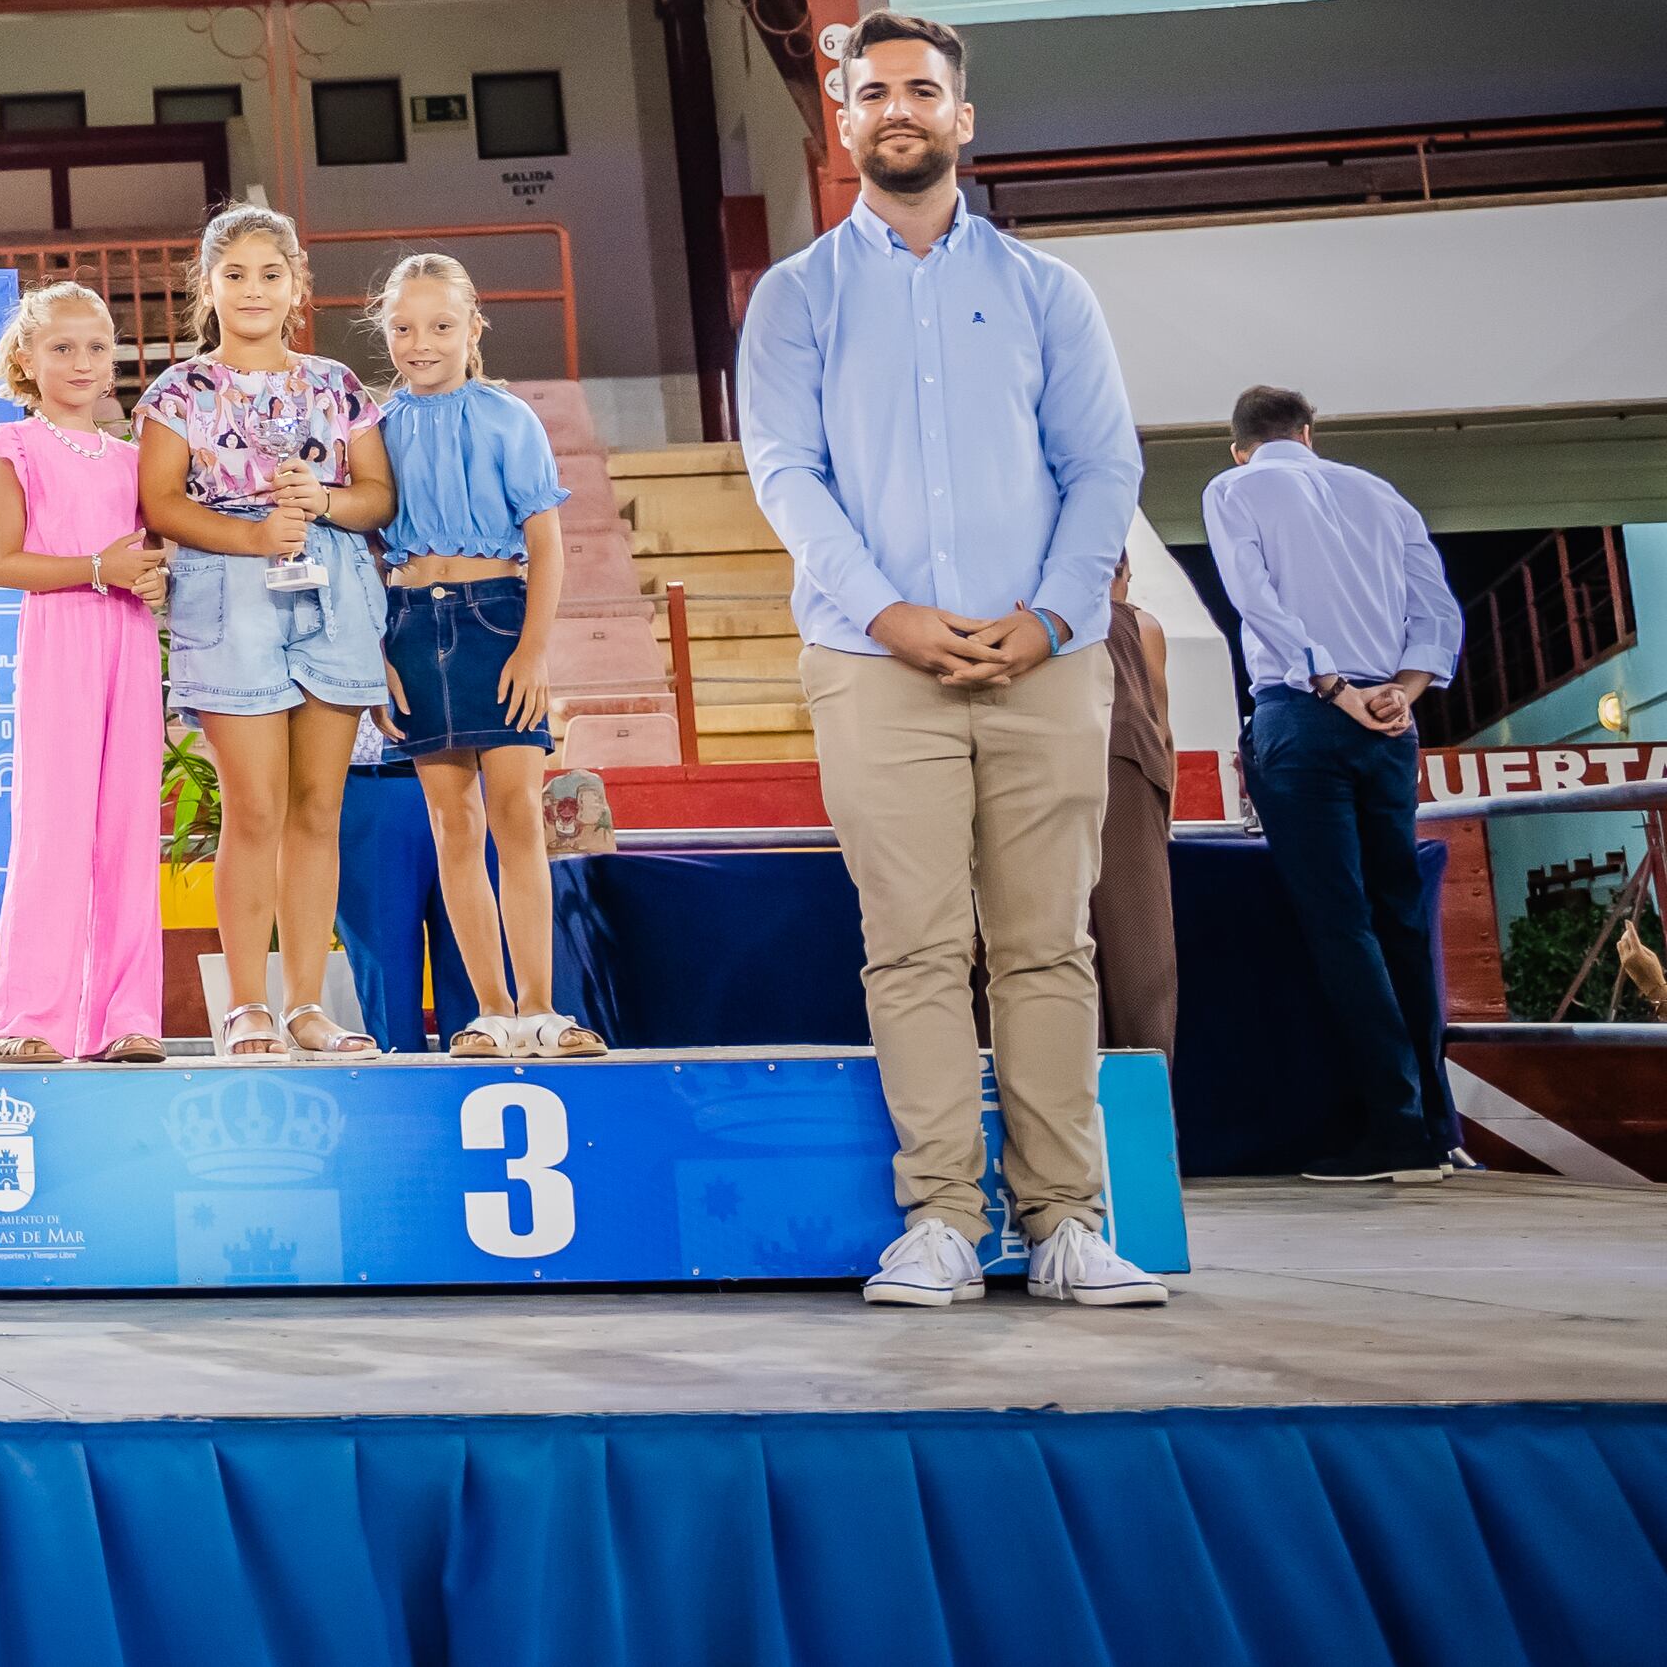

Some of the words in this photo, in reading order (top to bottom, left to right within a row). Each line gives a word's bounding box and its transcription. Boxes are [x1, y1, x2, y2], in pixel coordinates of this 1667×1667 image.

[501, 169, 555, 184] SALIDA
[511, 184, 546, 197] EXIT
[1418, 746, 1667, 802] UERT
[459, 1082, 577, 1259] 3
[46, 1215, 60, 1225] DE
[22, 1230, 42, 1244] DE
[47, 1228, 86, 1244] MAR
